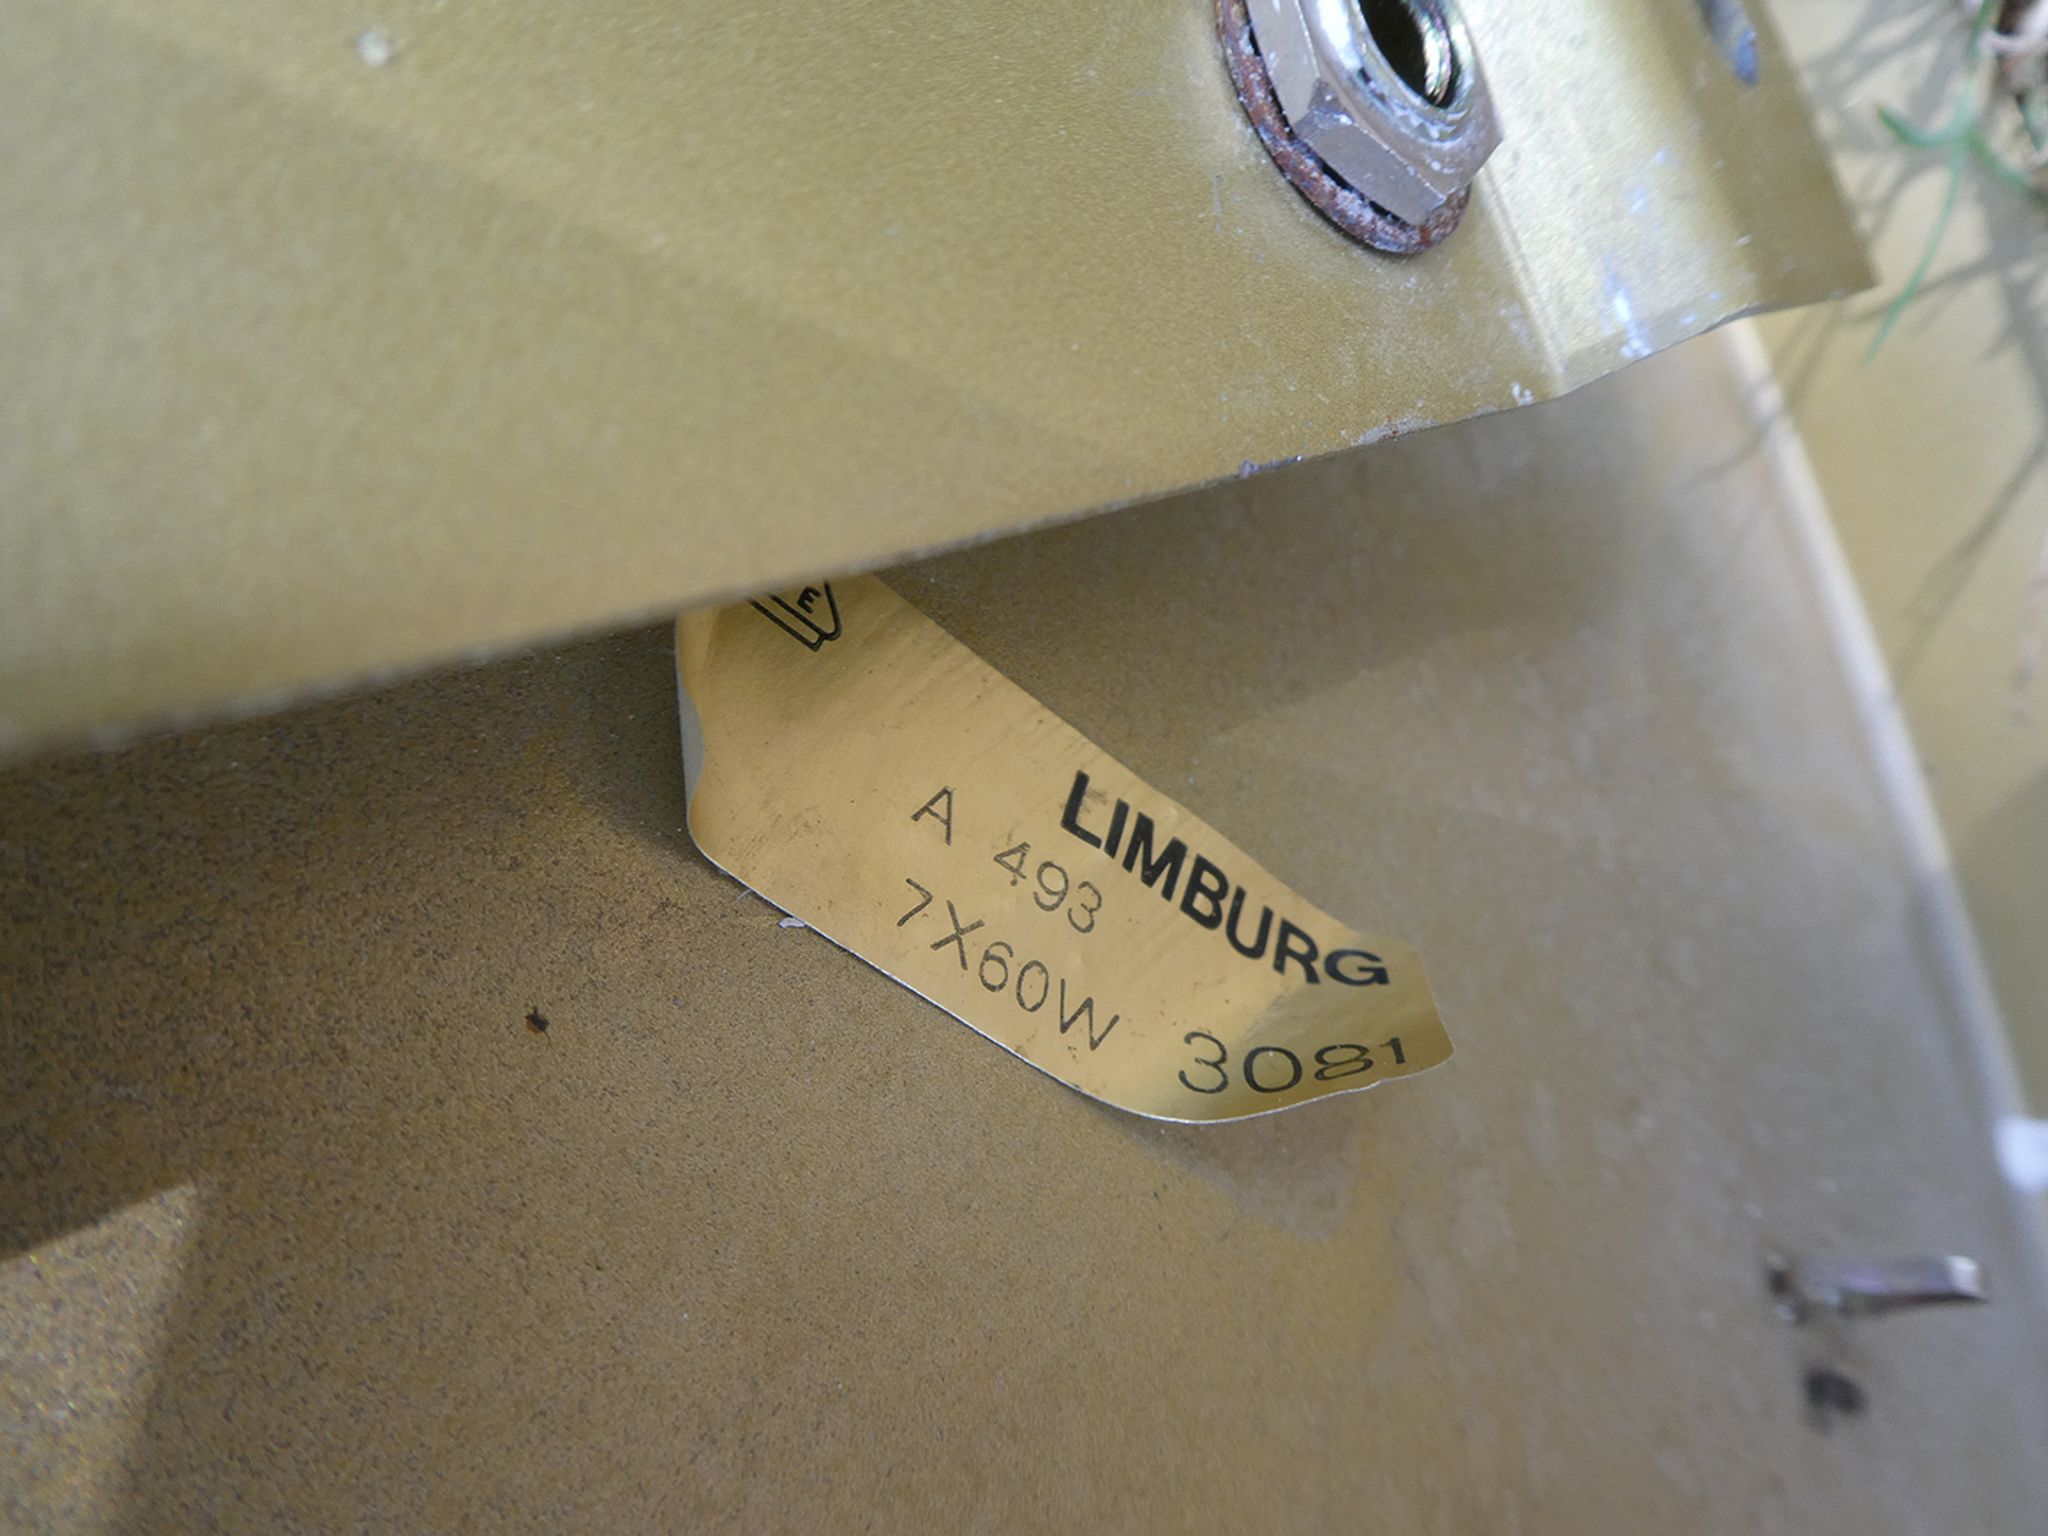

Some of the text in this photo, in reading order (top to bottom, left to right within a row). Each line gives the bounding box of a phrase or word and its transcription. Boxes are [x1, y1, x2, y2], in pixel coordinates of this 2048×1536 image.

[910, 785, 1102, 934] A 493
[1060, 769, 1390, 987] LIMBURG
[897, 878, 1120, 1051] 7X60W
[1177, 1031, 1407, 1095] 3081
